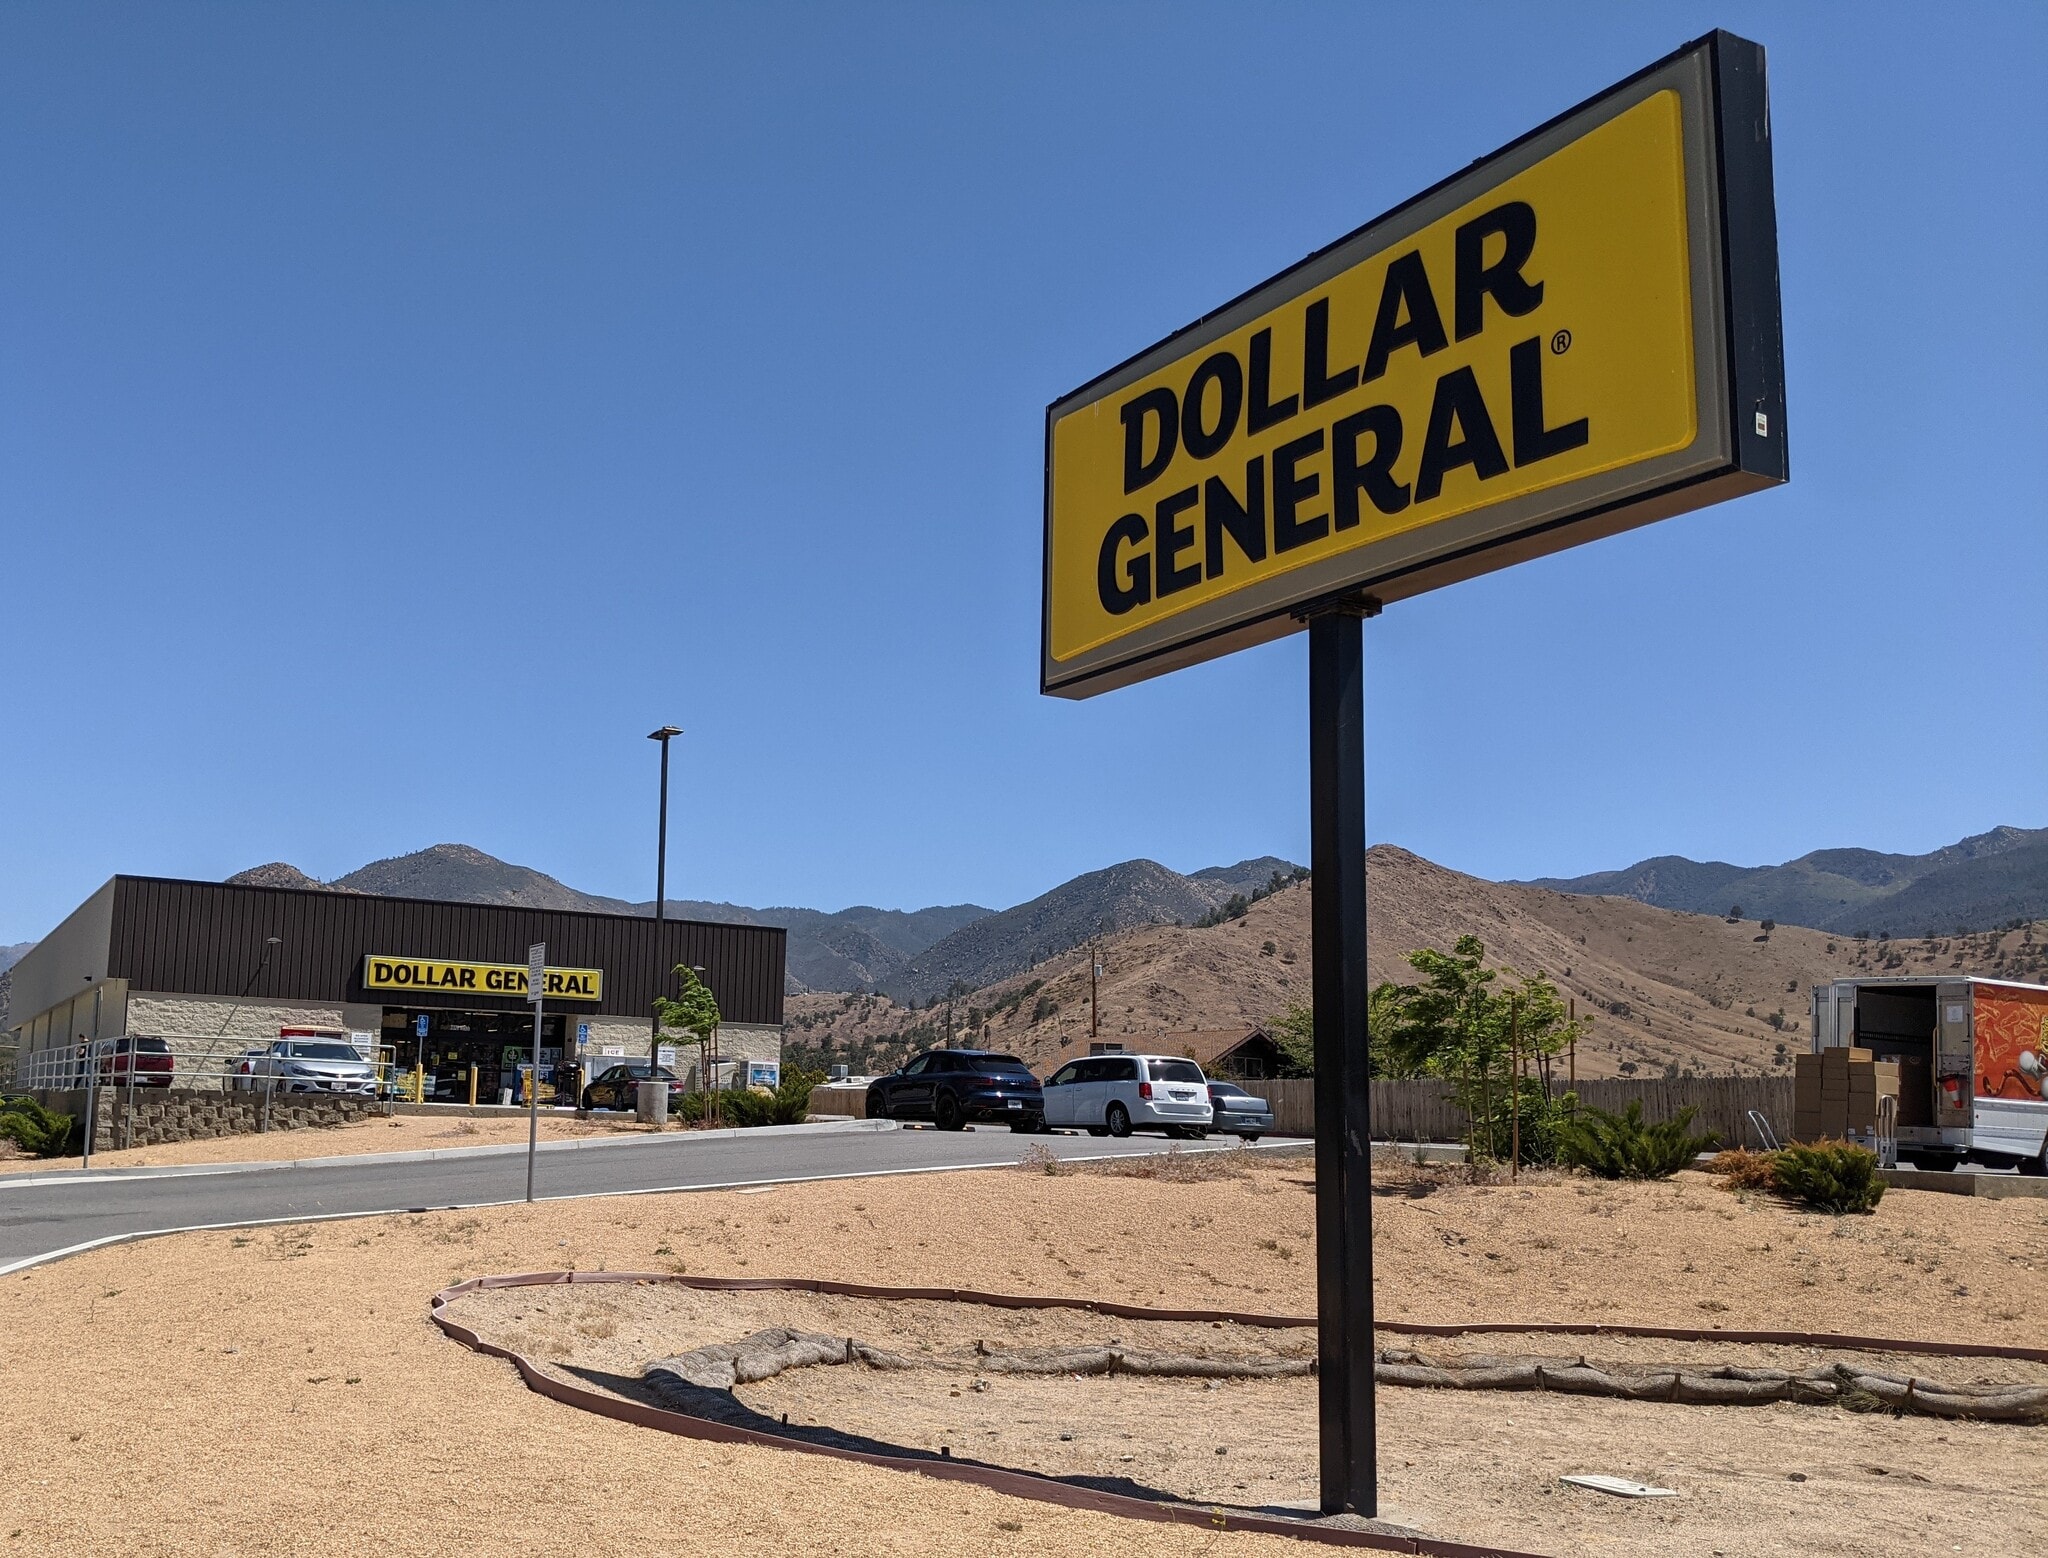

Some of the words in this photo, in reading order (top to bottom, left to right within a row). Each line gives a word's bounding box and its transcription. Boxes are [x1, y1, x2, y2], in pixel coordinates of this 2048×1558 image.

[1097, 335, 1589, 615] GENERAL
[1120, 201, 1544, 495] DOLLAR
[374, 963, 476, 988] DOLLAR
